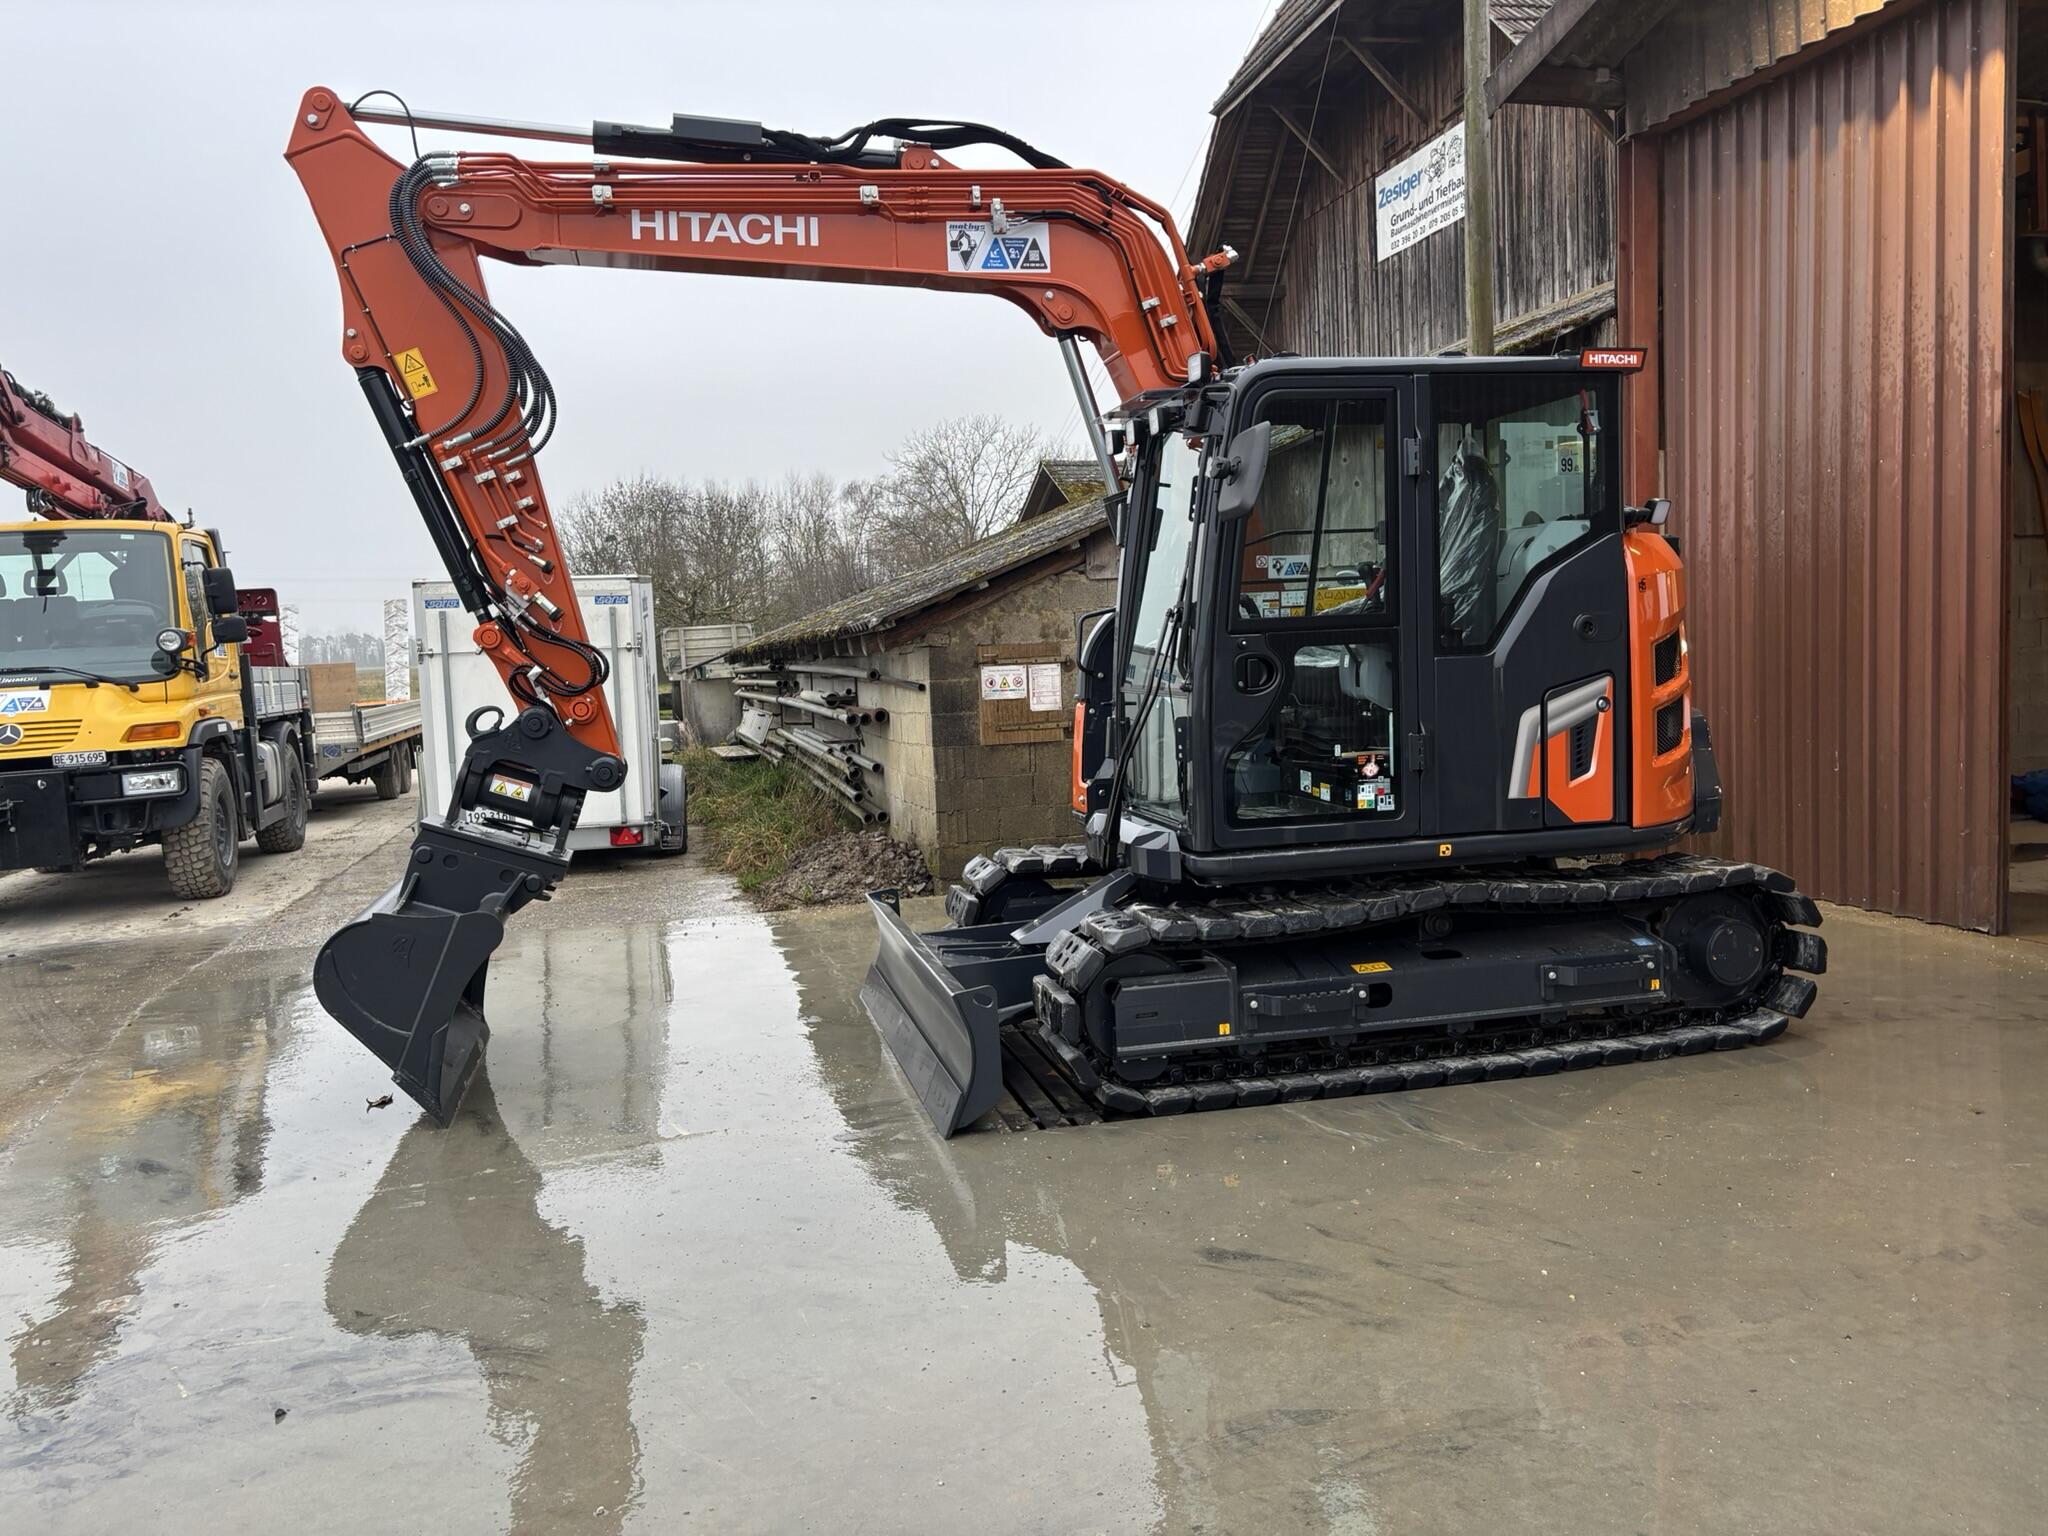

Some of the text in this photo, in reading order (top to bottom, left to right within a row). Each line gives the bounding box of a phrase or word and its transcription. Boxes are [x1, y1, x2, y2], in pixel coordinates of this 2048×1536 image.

[1378, 168, 1424, 209] Zesiger
[1390, 176, 1465, 226] Grund- und Tiefbau
[631, 208, 819, 246] HITACHI
[1588, 354, 1637, 364] HITACHI
[1561, 457, 1573, 472] 99
